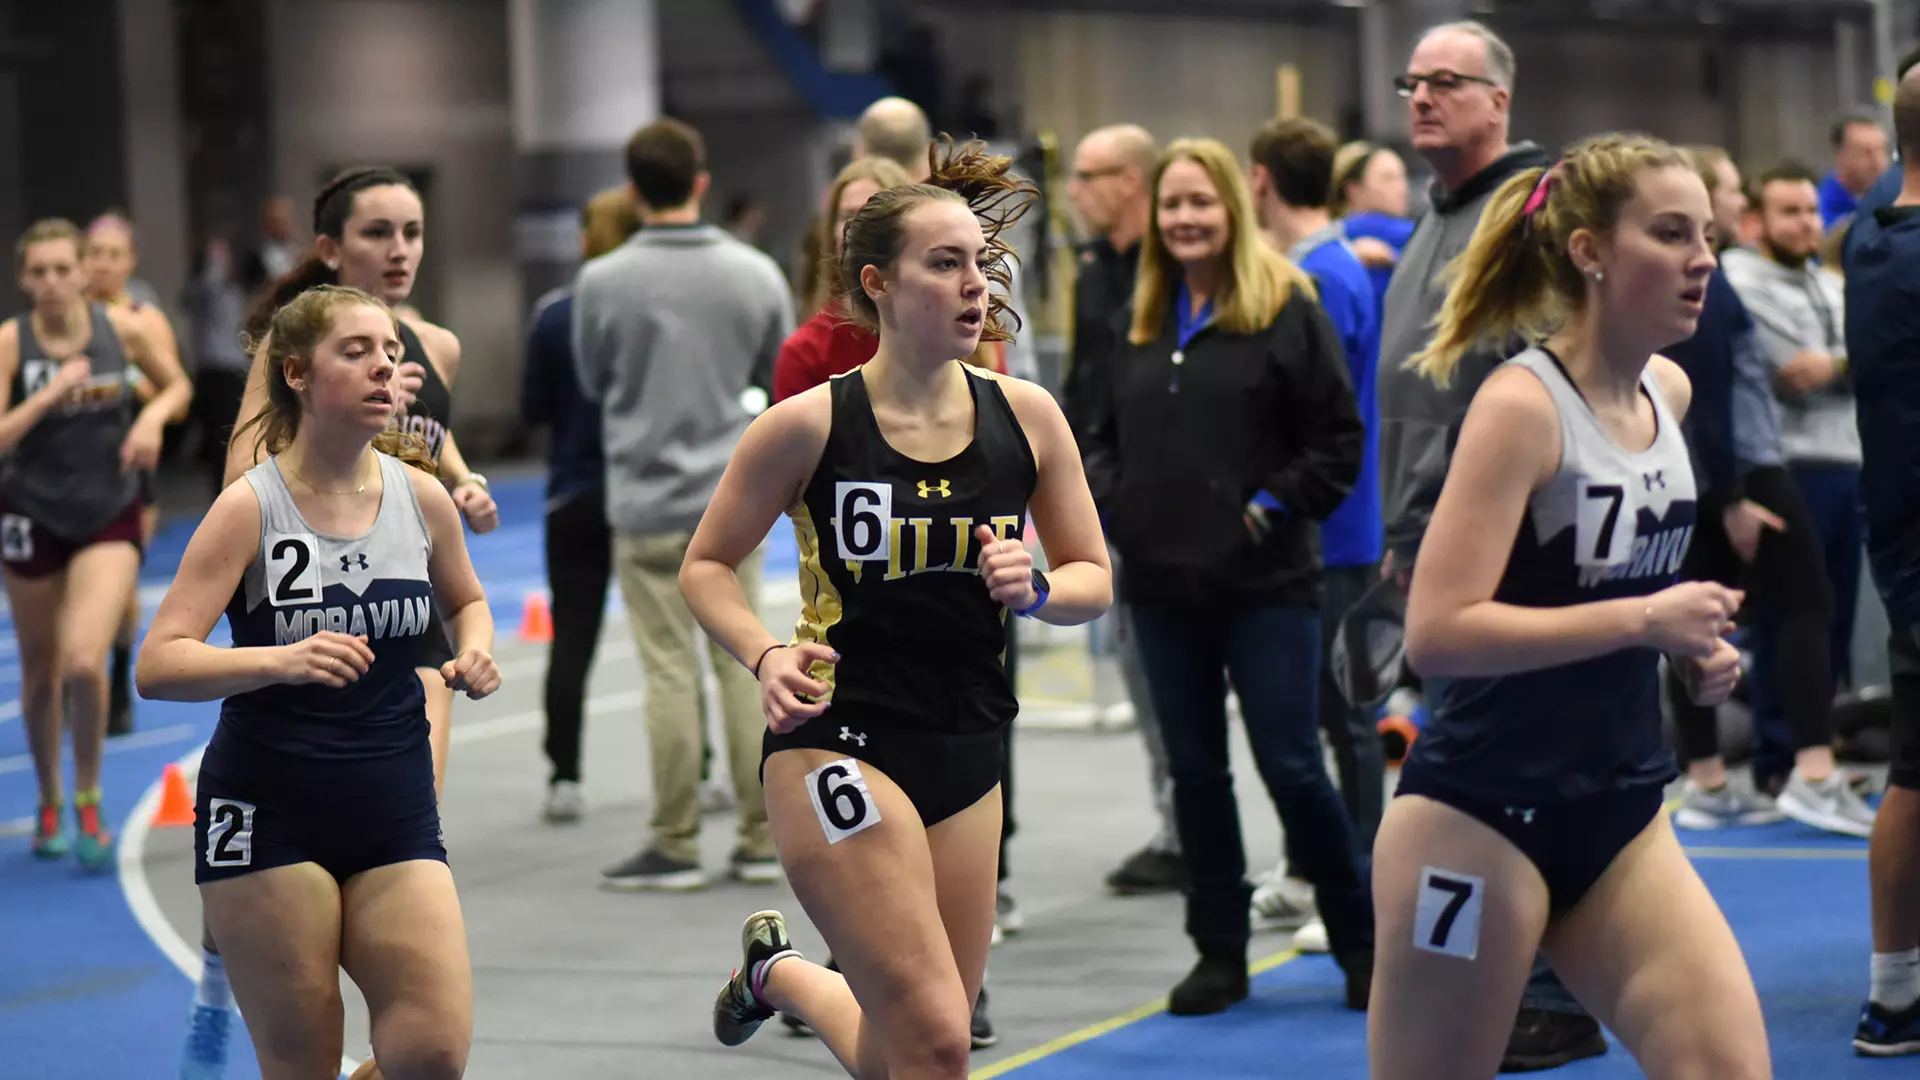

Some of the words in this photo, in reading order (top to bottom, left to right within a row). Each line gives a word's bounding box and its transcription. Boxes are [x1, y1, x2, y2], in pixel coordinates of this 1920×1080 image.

[830, 515, 1019, 584] ILL
[842, 488, 882, 555] 6
[1586, 485, 1624, 559] 7
[272, 539, 314, 600] 2
[275, 596, 430, 646] MORAVIAN
[817, 765, 867, 830] 6
[214, 804, 243, 861] 2
[1428, 874, 1473, 948] 7
